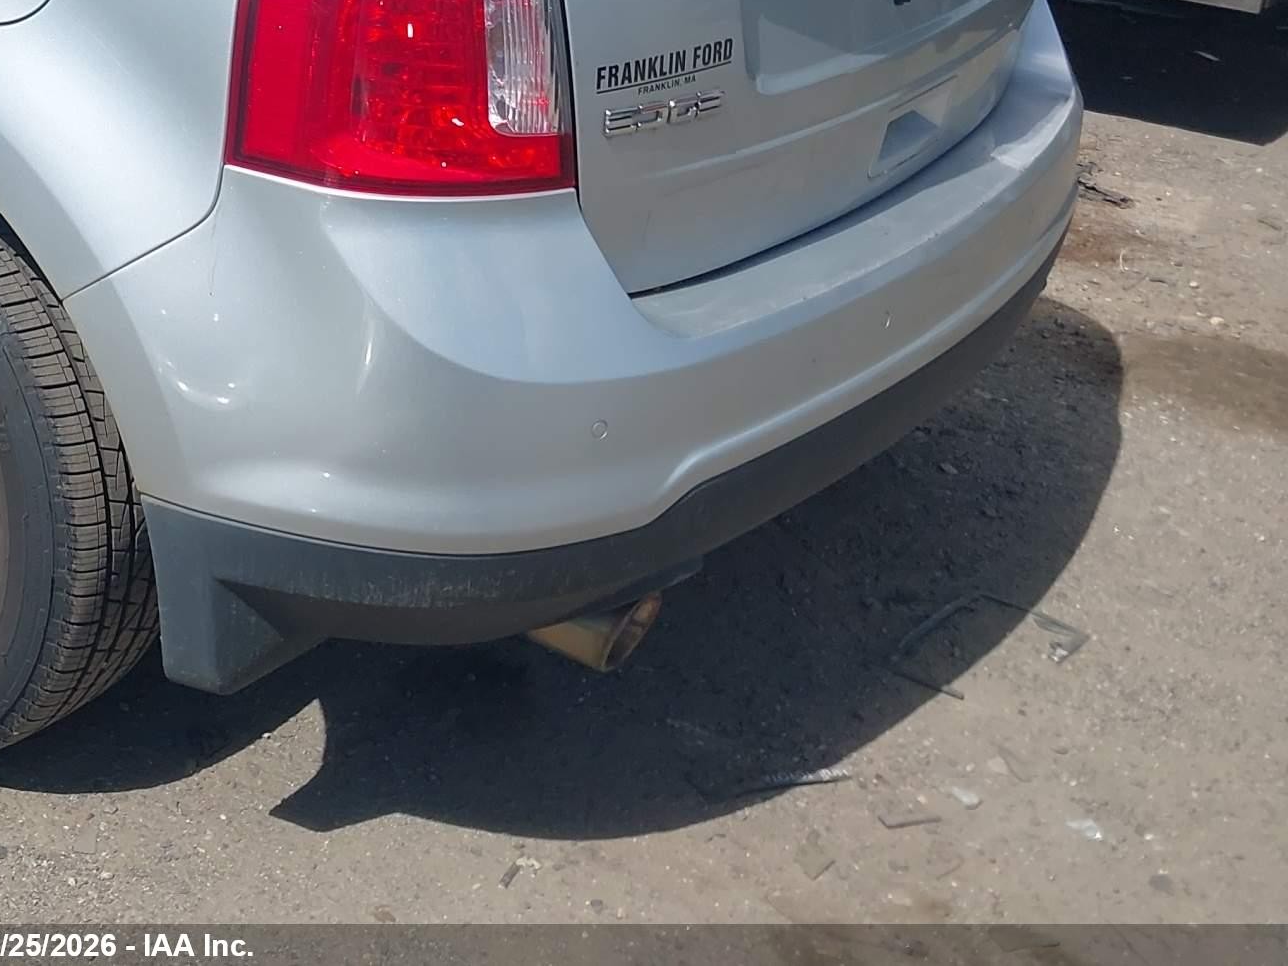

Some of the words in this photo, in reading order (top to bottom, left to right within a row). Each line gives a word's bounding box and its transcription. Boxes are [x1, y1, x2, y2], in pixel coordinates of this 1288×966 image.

[596, 49, 686, 90] FRANKLIN
[692, 38, 733, 68] FORD
[684, 75, 696, 85] MA
[603, 90, 725, 138] EDGE
